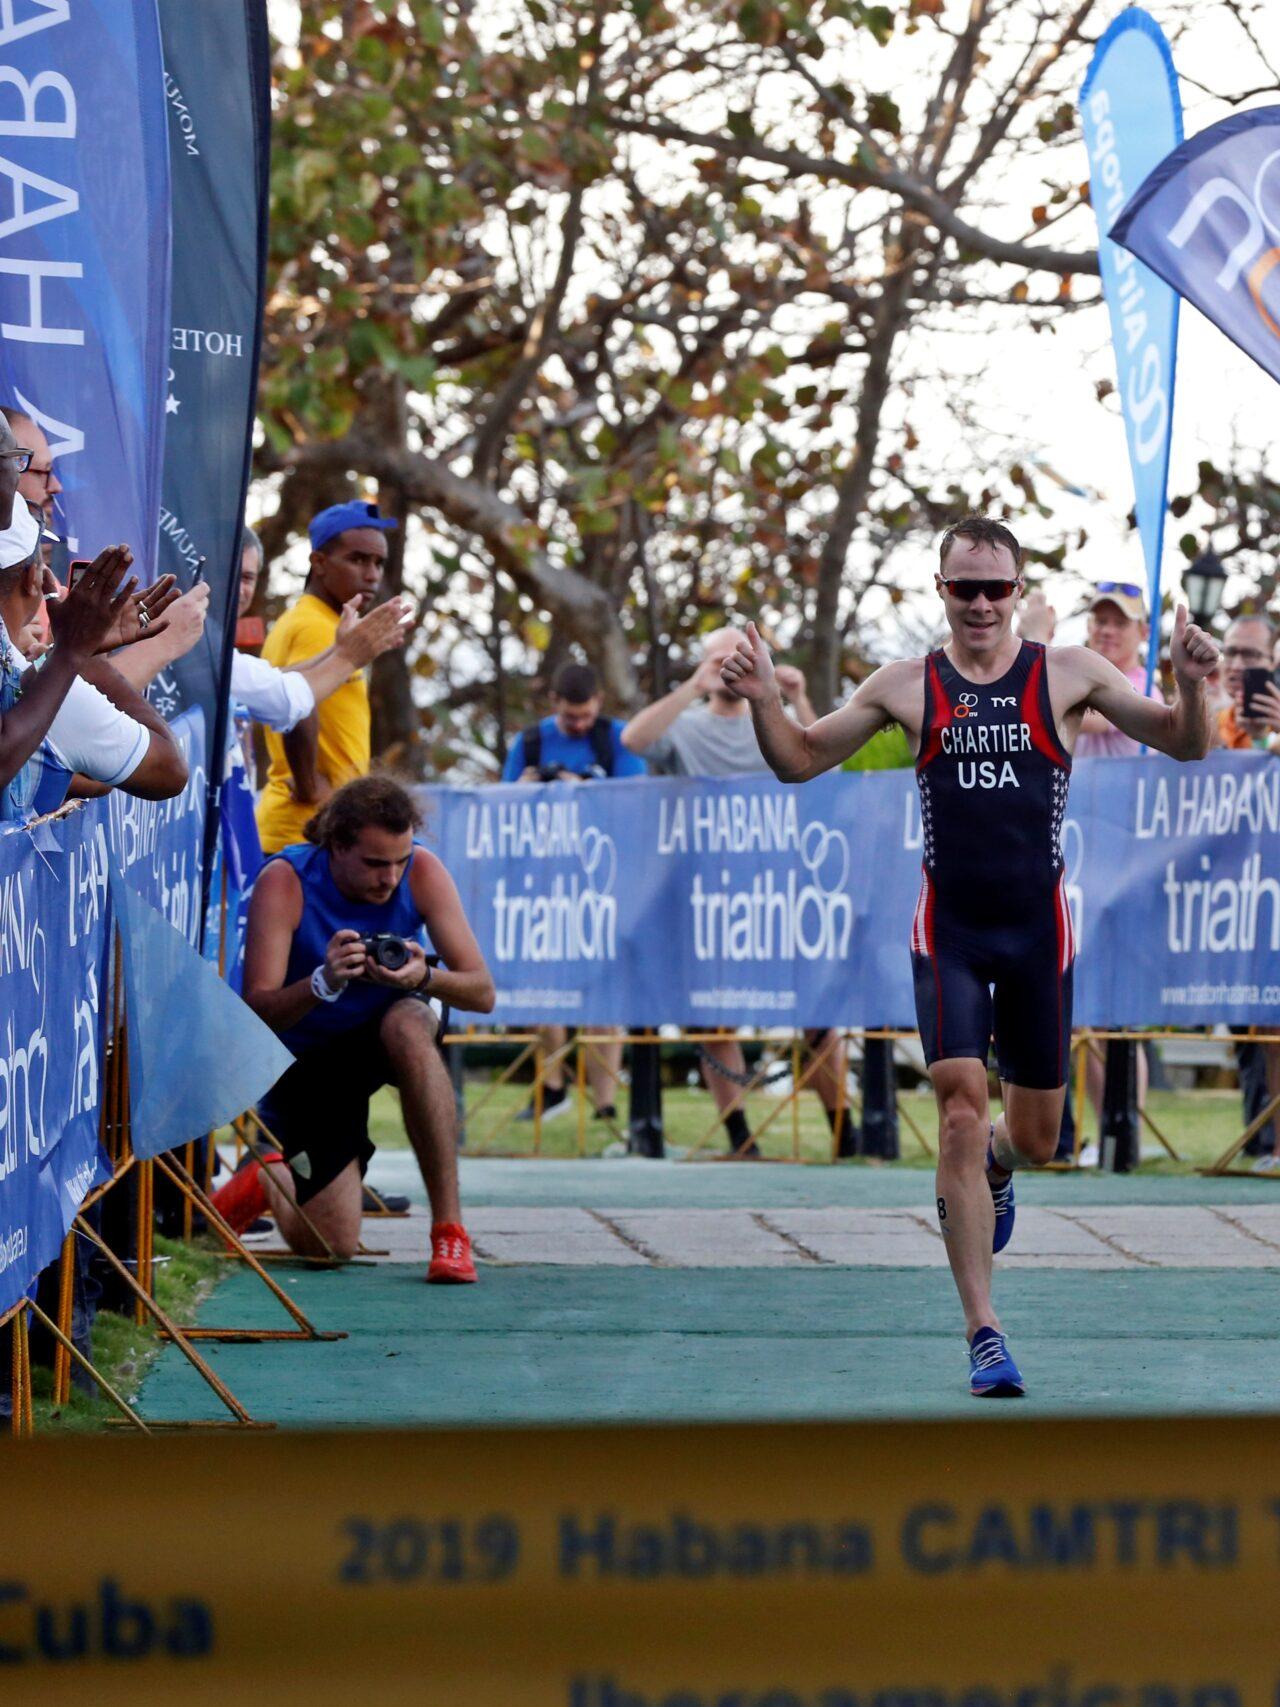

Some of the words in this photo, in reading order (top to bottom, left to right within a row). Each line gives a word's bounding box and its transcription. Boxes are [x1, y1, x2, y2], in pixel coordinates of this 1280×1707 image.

[991, 697, 1017, 707] TYR
[941, 723, 1032, 755] CHARTIER
[958, 761, 1021, 789] USA
[466, 803, 494, 859] LA
[657, 797, 688, 855] LA
[692, 793, 800, 854] HABANA
[1135, 777, 1170, 839] LA
[493, 873, 617, 962] triathlon
[690, 867, 852, 962] triathlon
[340, 1516, 519, 1583] 2019
[558, 1512, 873, 1578] Habana
[902, 1498, 1238, 1572] CAMTRI
